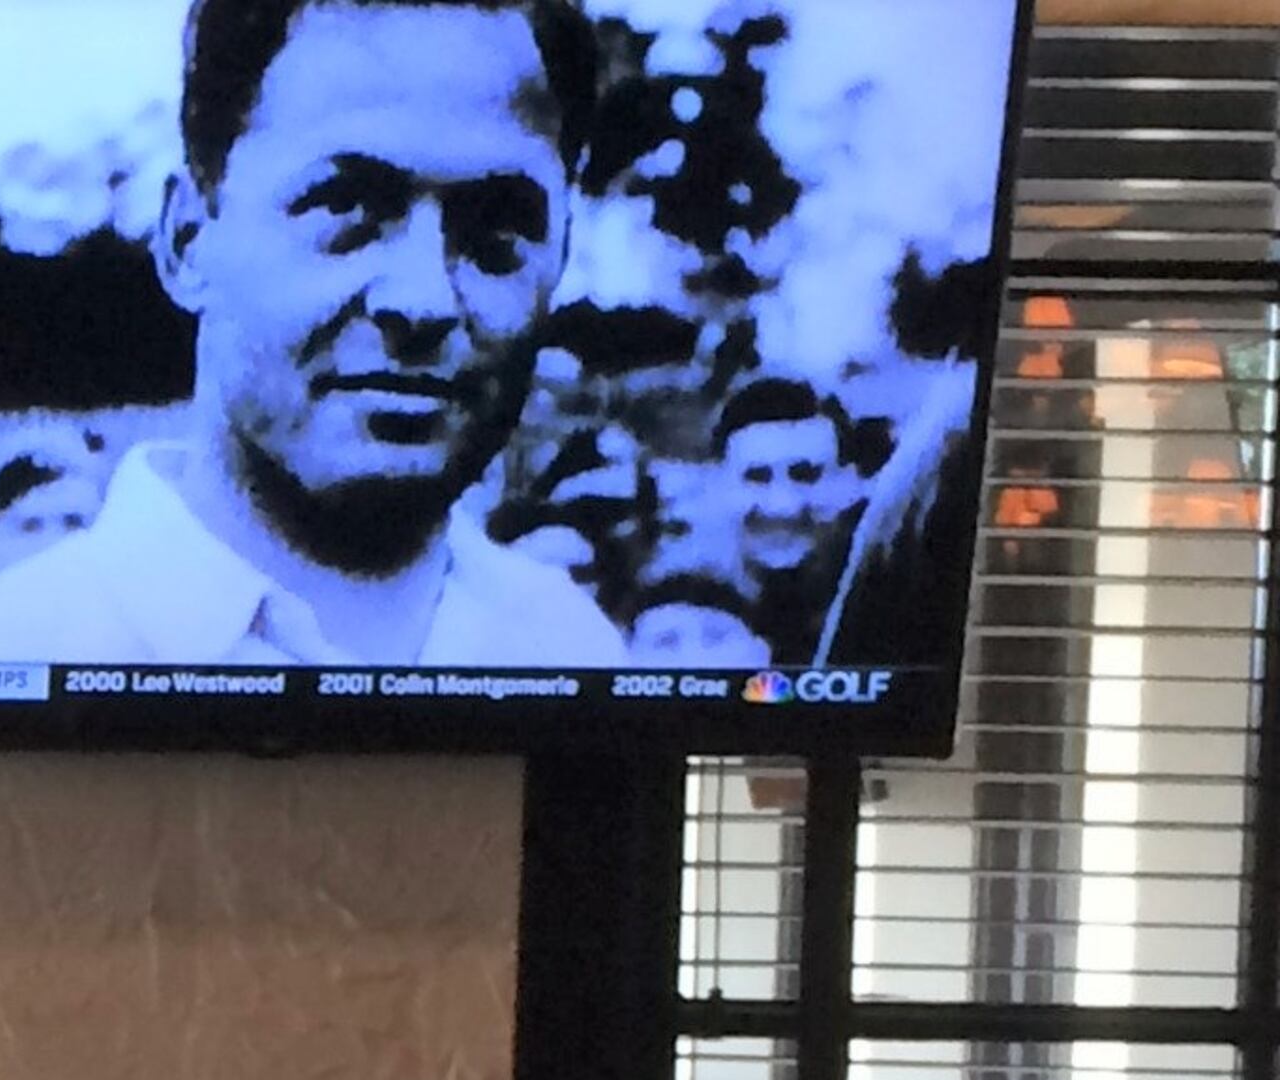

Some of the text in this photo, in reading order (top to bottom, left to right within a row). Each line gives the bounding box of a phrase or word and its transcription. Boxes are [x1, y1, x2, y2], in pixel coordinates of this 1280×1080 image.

[65, 671, 125, 692] 2000
[132, 672, 170, 692] Lee
[172, 672, 285, 694] Westwood
[318, 673, 373, 694] 2001
[380, 673, 433, 695] Colin
[436, 674, 579, 699] Montgomerie
[612, 675, 673, 697] 2002
[795, 670, 892, 702] GOLF
